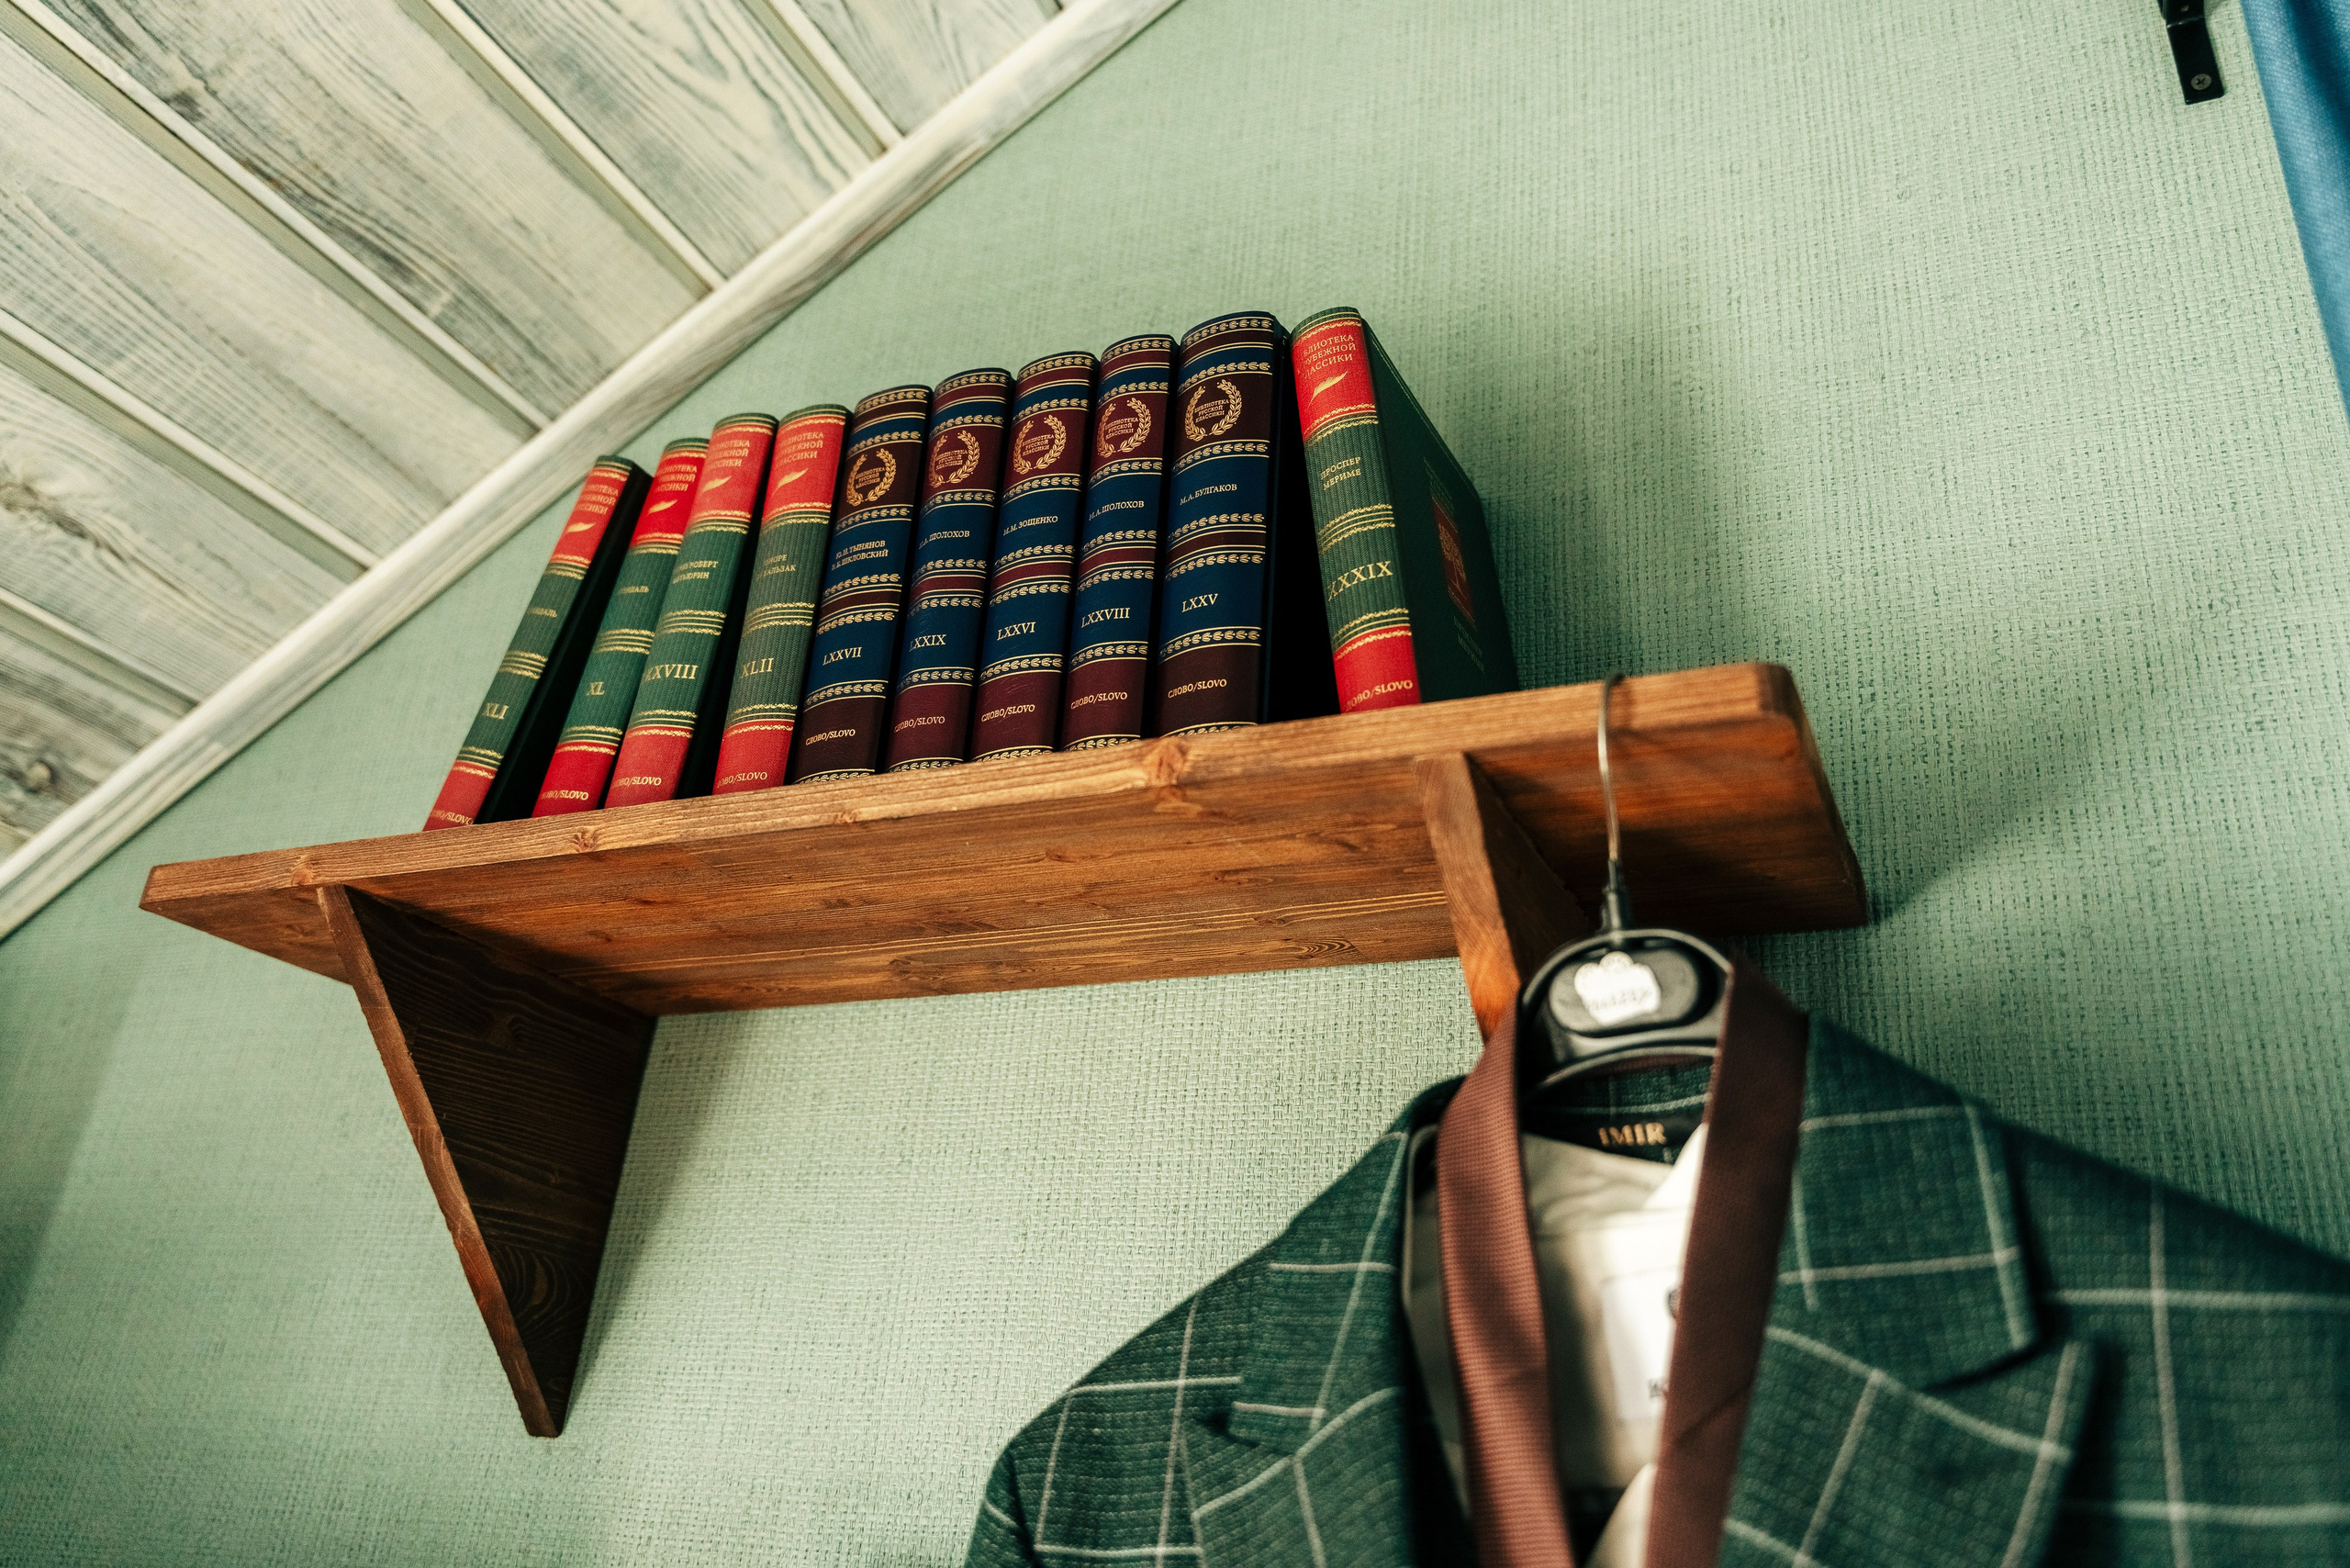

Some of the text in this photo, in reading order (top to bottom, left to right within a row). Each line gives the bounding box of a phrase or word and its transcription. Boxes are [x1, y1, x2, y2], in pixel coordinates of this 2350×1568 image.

[1303, 334, 1354, 356] БЛИОТЕКА
[1304, 342, 1356, 364] УБЕЖНОЙ
[1304, 353, 1353, 377] ЛАССИКИ
[1194, 398, 1229, 413] БИБЛИОТЕКА
[1198, 405, 1224, 417] РУССКОЙ
[1195, 410, 1225, 423] КЛАССИКИ
[1105, 428, 1134, 440] КЛАССИКИ
[1108, 423, 1133, 434] РУССКОЙ
[1320, 456, 1361, 480] ПРОСПЕР
[1323, 467, 1362, 491] МЕРИМЕ
[1194, 483, 1237, 498] БУЛГАКОВ
[1102, 500, 1145, 513] ШОЛОХОВ
[1018, 515, 1058, 529] ЗОЩЕНКО
[928, 530, 970, 542] ШОЛОХОВ
[849, 540, 886, 554] ТЫНЯНОВ
[688, 560, 719, 569] РОБЕРТ
[841, 549, 889, 566] ШКЛОВСКИЙ
[672, 571, 710, 585] ТЬЮРИН
[1326, 560, 1393, 601] XXXIX
[1181, 593, 1218, 613] LXXV
[1080, 607, 1130, 629] LXXVIII
[996, 622, 1036, 642] LXXVI
[909, 633, 946, 652] LXXIX
[822, 646, 862, 666] LXXVII
[740, 657, 774, 678] XLII
[586, 681, 605, 696] XL
[1168, 678, 1227, 699] СЛОВО/SLOVO
[1346, 679, 1414, 711] ЛОВО/SLOVO
[1070, 691, 1128, 710] СЛОВО/SLOVO
[482, 702, 509, 720] XLI
[981, 704, 1035, 722] СЛОВО/SLOVO
[805, 728, 856, 745] СЛОВО/SLOVO
[716, 771, 768, 789] ОВО/SLOVO
